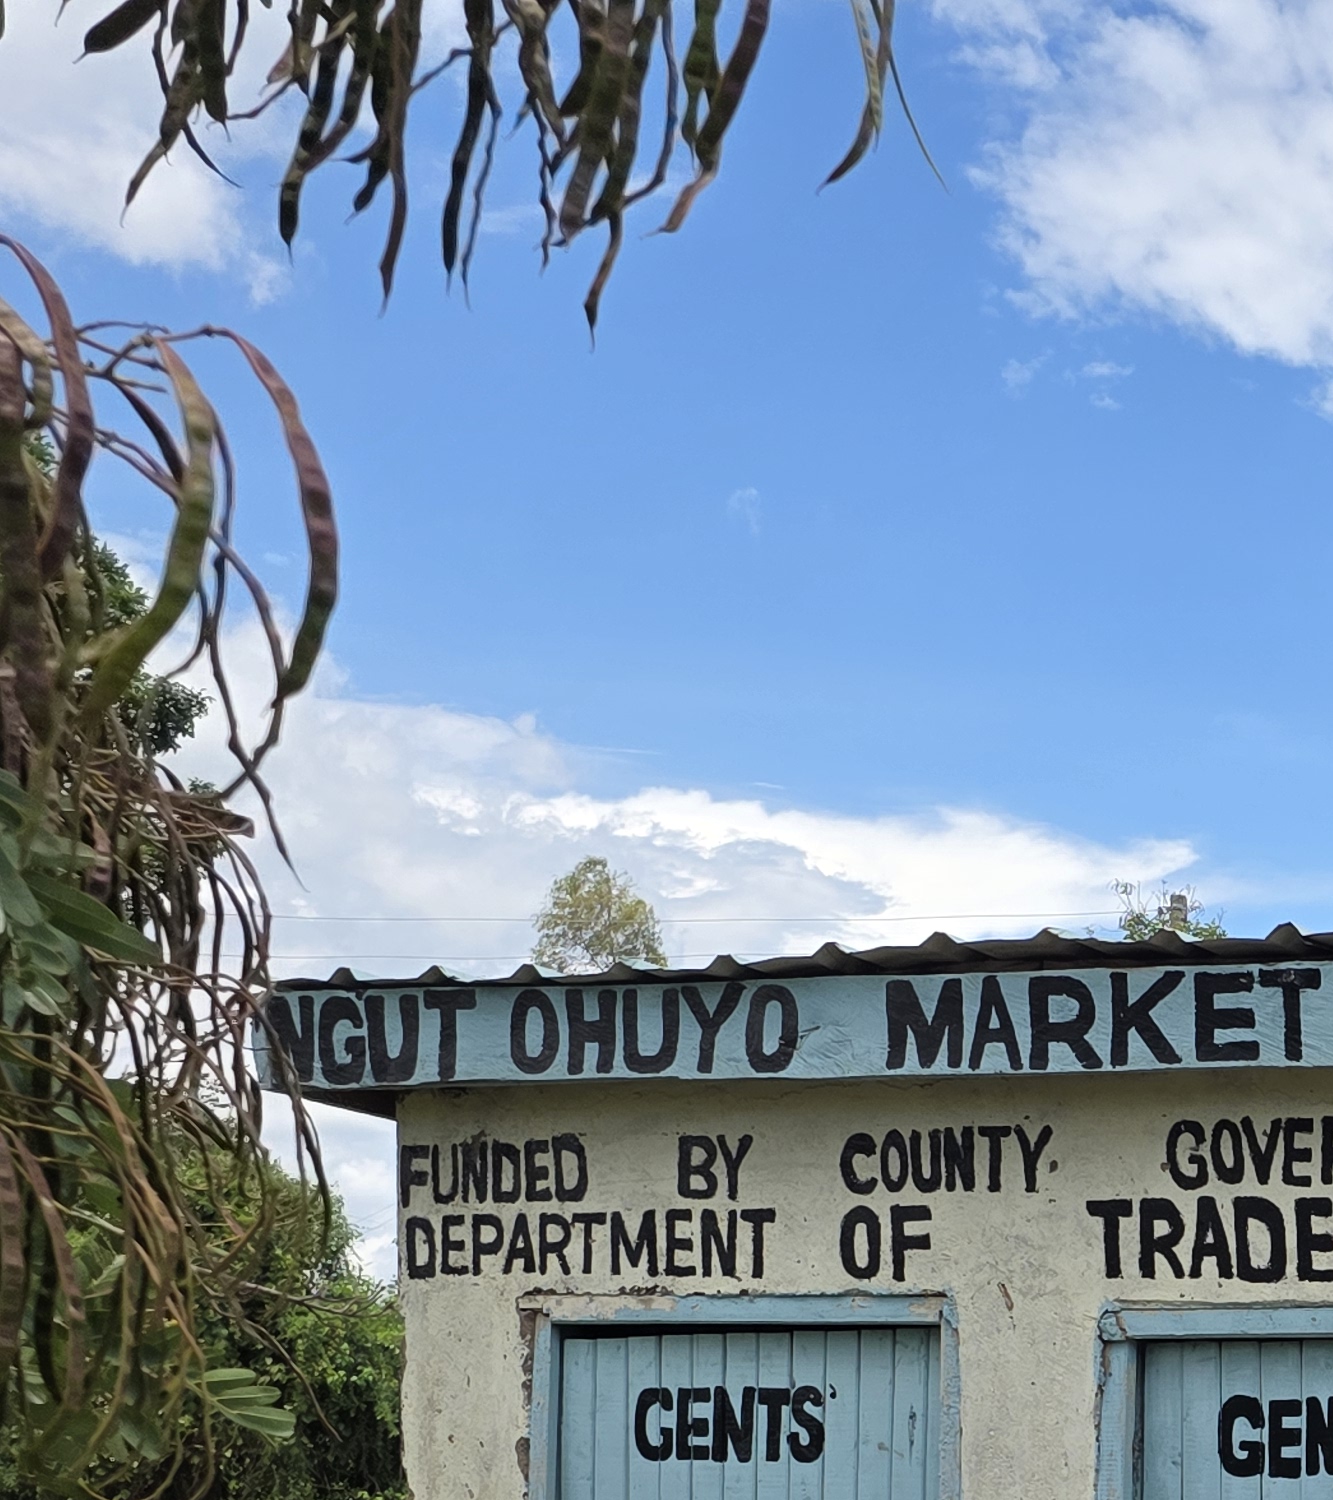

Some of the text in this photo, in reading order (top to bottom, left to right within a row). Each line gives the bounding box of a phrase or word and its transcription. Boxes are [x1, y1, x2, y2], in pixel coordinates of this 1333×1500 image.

[509, 981, 799, 1075] OHUYO
[885, 968, 1322, 1071] MARKET
[400, 1131, 588, 1208] FUNDED
[677, 1133, 753, 1201] BY
[405, 1207, 776, 1280] DEPARTMENT
[839, 1204, 932, 1282] OF
